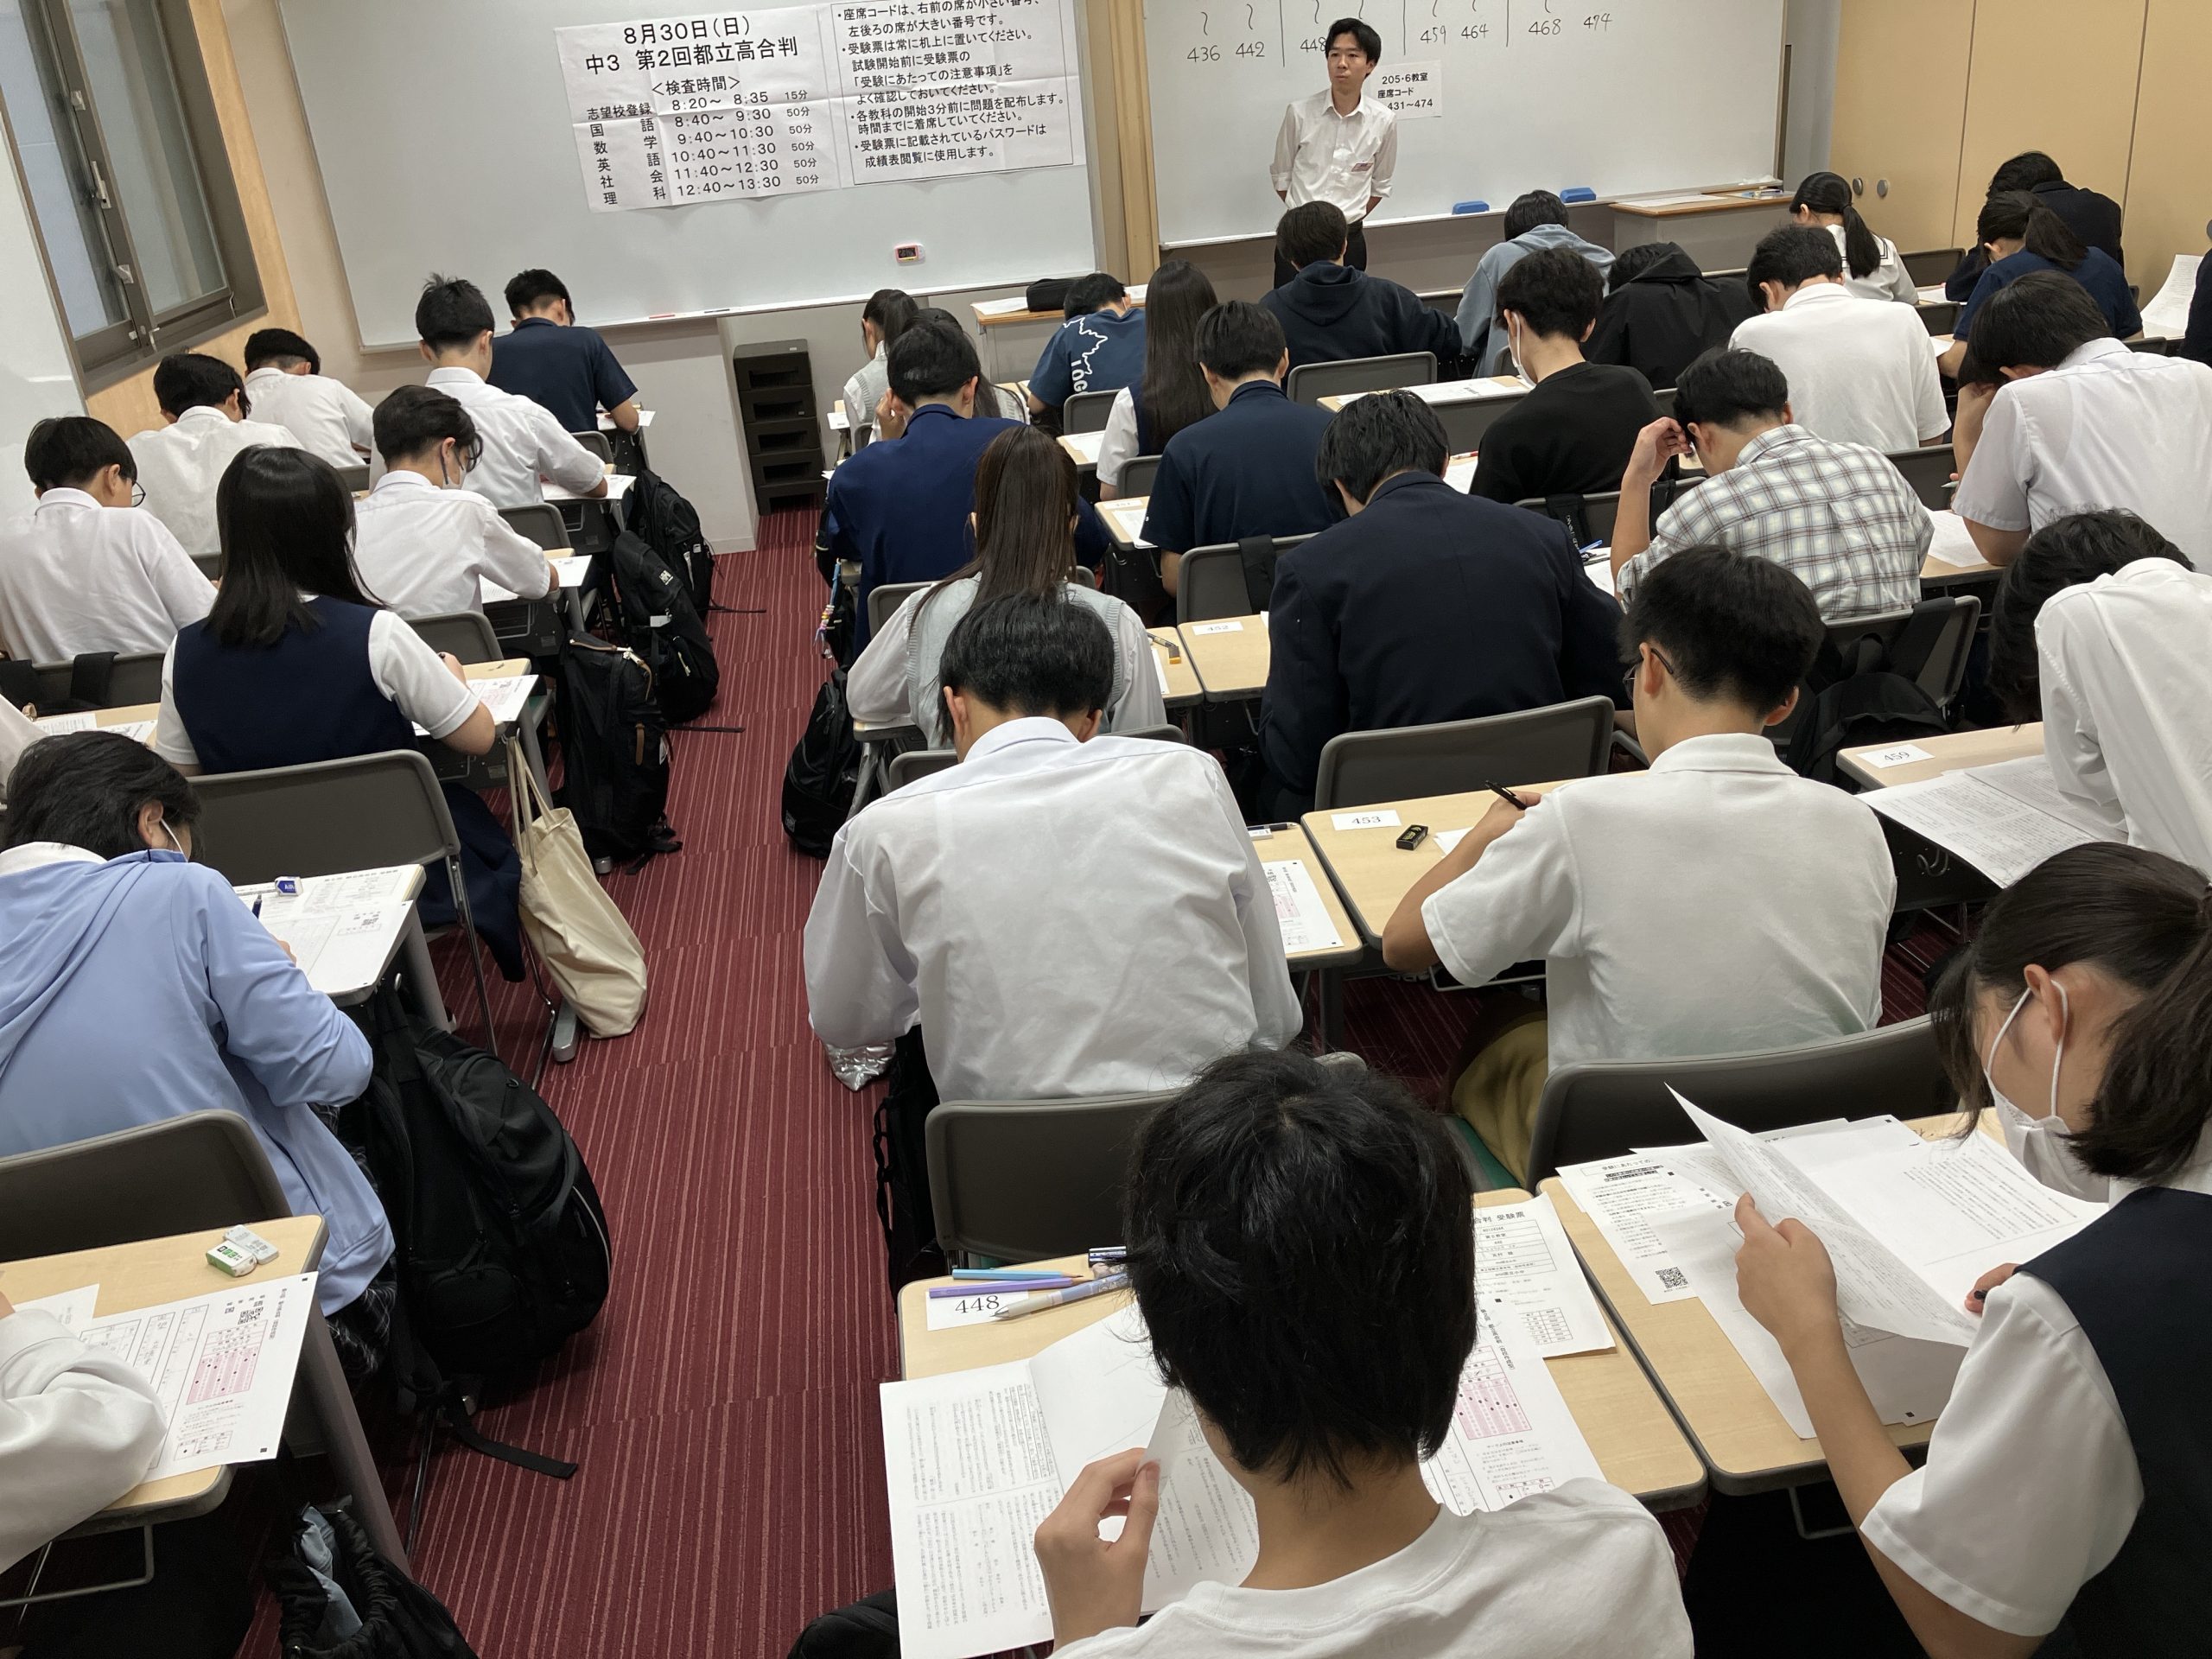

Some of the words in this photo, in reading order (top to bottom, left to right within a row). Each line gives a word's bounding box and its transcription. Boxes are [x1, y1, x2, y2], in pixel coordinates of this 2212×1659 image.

[1186, 44, 1221, 63] 436
[1235, 40, 1266, 59] 442
[1300, 37, 1326, 53] 448
[1420, 25, 1447, 44] 459
[1460, 22, 1490, 41] 464
[1528, 18, 1562, 36] 468
[1583, 13, 1613, 32] 474
[586, 54, 620, 74] 中3
[636, 36, 798, 71] 第2回都立高合判
[852, 50, 970, 73] 試験開始前に受験票の
[588, 103, 653, 120] 志望校登録
[785, 90, 807, 100] 15分
[1377, 87, 1414, 99] 座席コード
[591, 124, 604, 137] 国
[640, 118, 654, 132] 語
[786, 107, 810, 118] 50分
[594, 141, 608, 155] 数
[644, 136, 658, 149] 学
[789, 124, 812, 135] 50分
[597, 158, 611, 172] 英
[647, 153, 661, 166] 語
[791, 141, 815, 151] 50分
[601, 175, 614, 188] 社
[650, 169, 664, 183] 会
[794, 158, 817, 168] 50分
[604, 192, 618, 205] 理
[653, 187, 666, 200] 科
[796, 175, 819, 185] 50分
[1884, 751, 1910, 761] 459
[1351, 816, 1382, 825] 453
[955, 1294, 1001, 1314] 448
